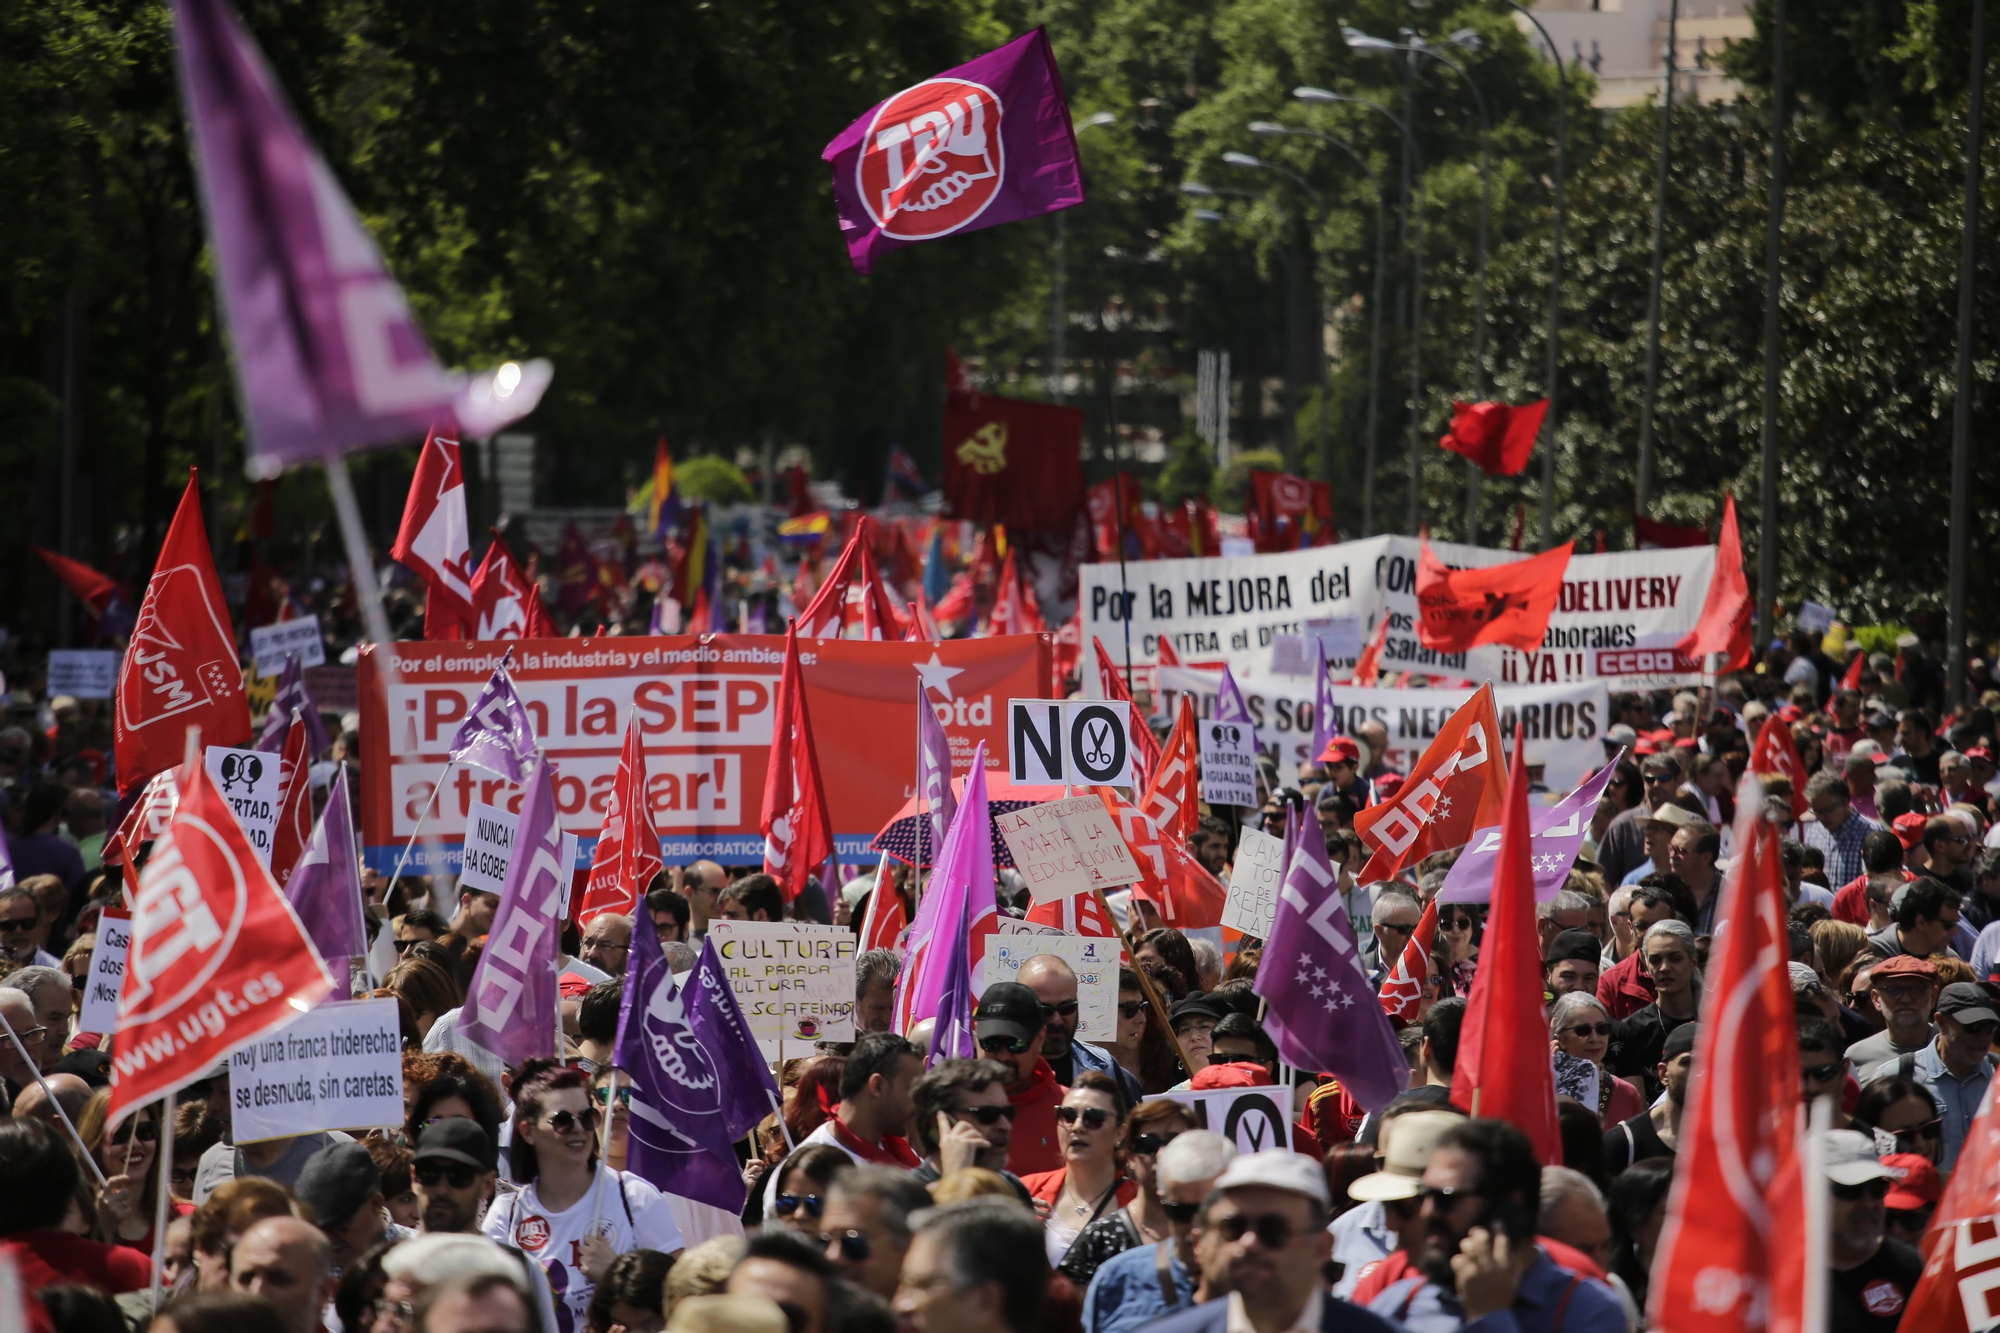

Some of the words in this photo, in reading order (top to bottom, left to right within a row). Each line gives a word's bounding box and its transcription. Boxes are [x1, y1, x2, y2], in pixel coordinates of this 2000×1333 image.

[1092, 586, 1137, 622] Por
[1150, 584, 1173, 619] la
[1187, 575, 1292, 618] MEJORA
[1311, 566, 1350, 604] del
[1559, 575, 1682, 613] DELIVERY
[1232, 631, 1248, 650] el
[389, 656, 422, 673] Por
[424, 654, 443, 672] el
[523, 651, 541, 670] la
[542, 649, 627, 669] industria
[628, 652, 641, 668] y
[643, 648, 660, 664] el
[663, 646, 721, 664] medio
[722, 648, 817, 665] ambiee:
[1600, 652, 1674, 674] CCOO
[134, 648, 193, 709] JSM
[405, 689, 549, 750] ¡Pn
[565, 685, 617, 737] la
[951, 747, 989, 757] Trabao
[1013, 705, 1126, 782] NO
[404, 780, 441, 820] a
[453, 758, 727, 816] trabaar!
[477, 817, 509, 849] NUNCA
[1020, 828, 1076, 861] MATA
[1084, 823, 1107, 840] LA
[465, 847, 478, 873] HA
[1257, 886, 1271, 899] DE
[721, 939, 856, 962] CULTURA
[765, 965, 831, 977] PAGADA
[261, 1041, 285, 1063] una
[288, 1033, 328, 1060] franca
[331, 1026, 397, 1057] triderecha
[236, 1087, 250, 1110] se
[254, 1075, 316, 1107] desnuda,
[319, 1072, 340, 1099] sin
[344, 1071, 399, 1098] caretas.
[519, 1219, 548, 1237] UGT
